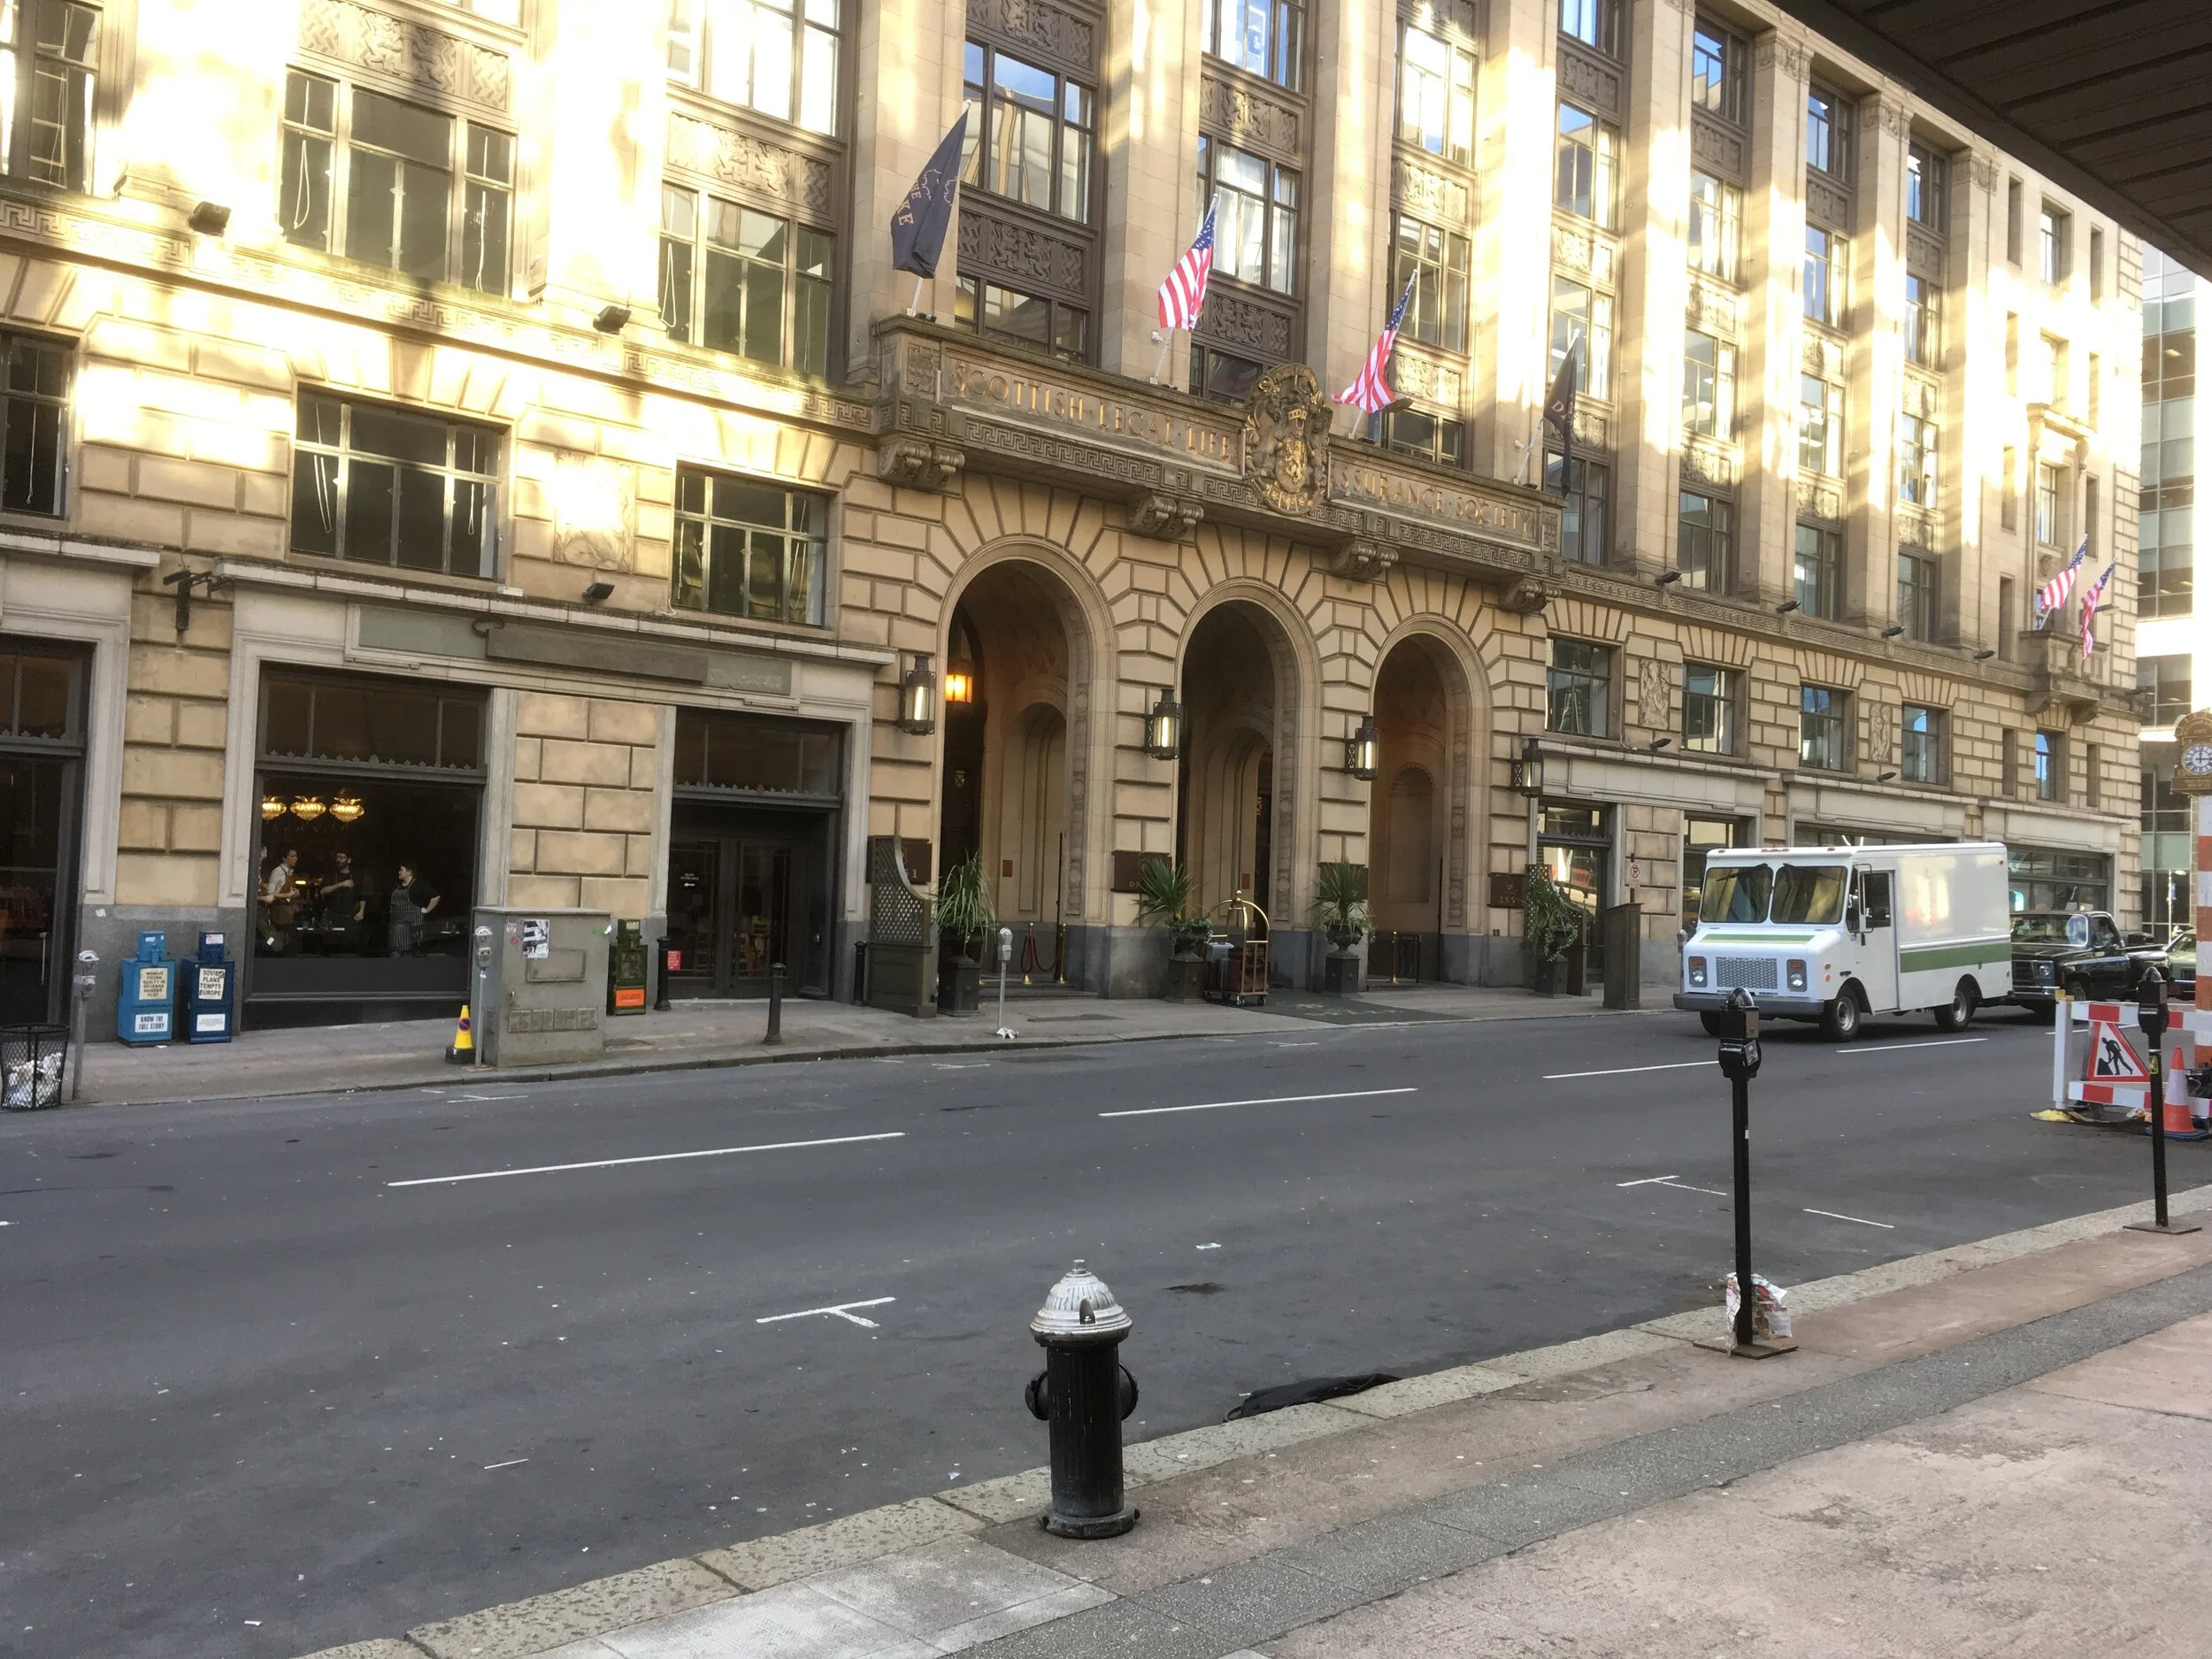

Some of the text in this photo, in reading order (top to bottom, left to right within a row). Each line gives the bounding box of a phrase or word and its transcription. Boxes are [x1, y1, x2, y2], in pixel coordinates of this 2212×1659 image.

[955, 364, 1084, 423] SCOTTISH
[1187, 423, 1230, 461] LIFE
[1330, 463, 1444, 514] SSURANCE
[1455, 495, 1532, 533] SOCIETY
